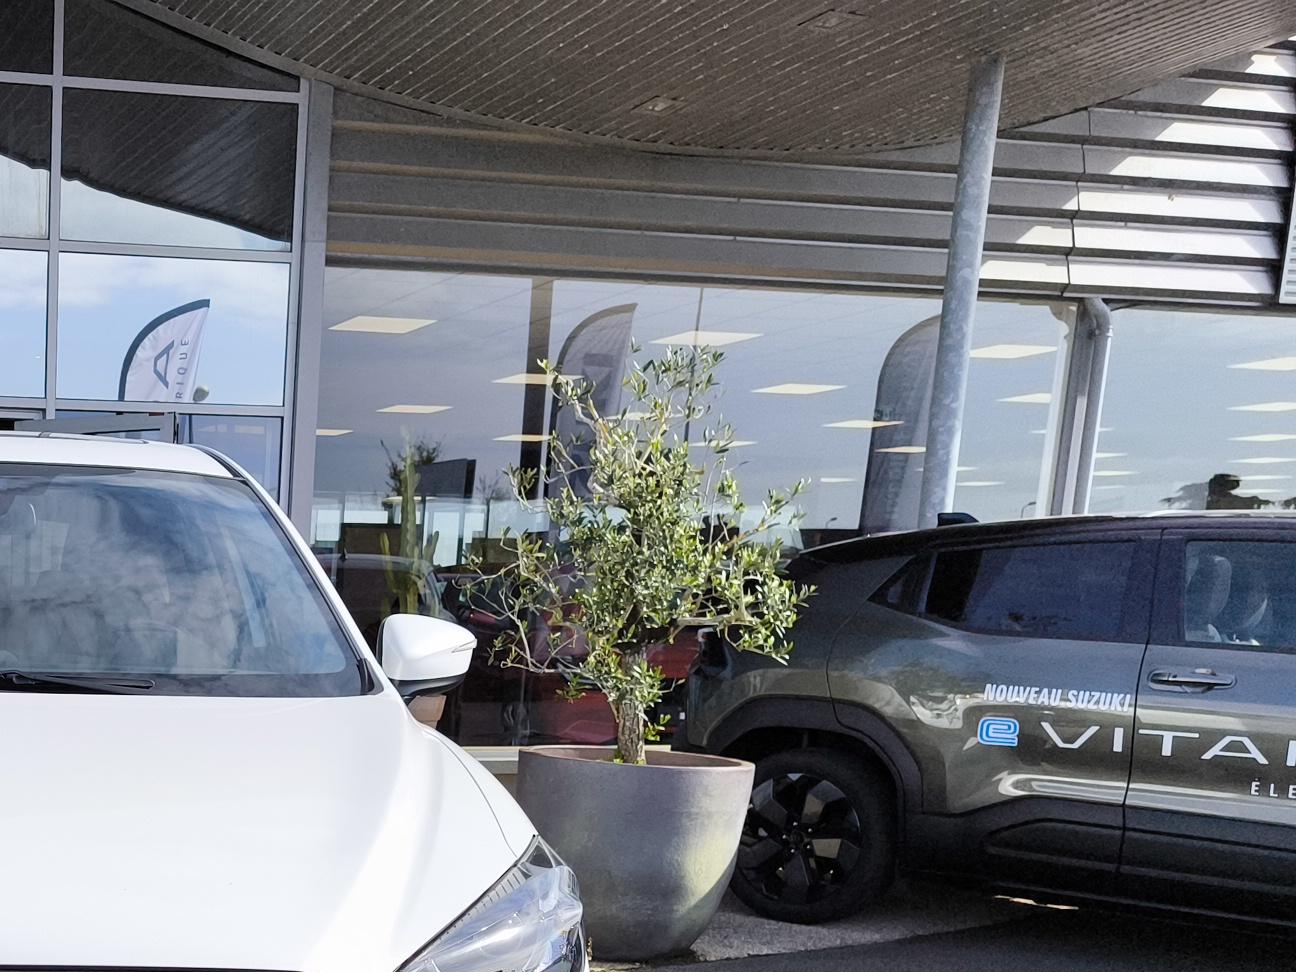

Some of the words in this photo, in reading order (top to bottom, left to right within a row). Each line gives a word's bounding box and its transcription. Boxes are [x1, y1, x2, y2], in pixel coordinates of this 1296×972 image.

[983, 683, 1062, 707] NOUVEAU
[1067, 689, 1132, 713] SUZUKI
[1040, 721, 1296, 767] VITA
